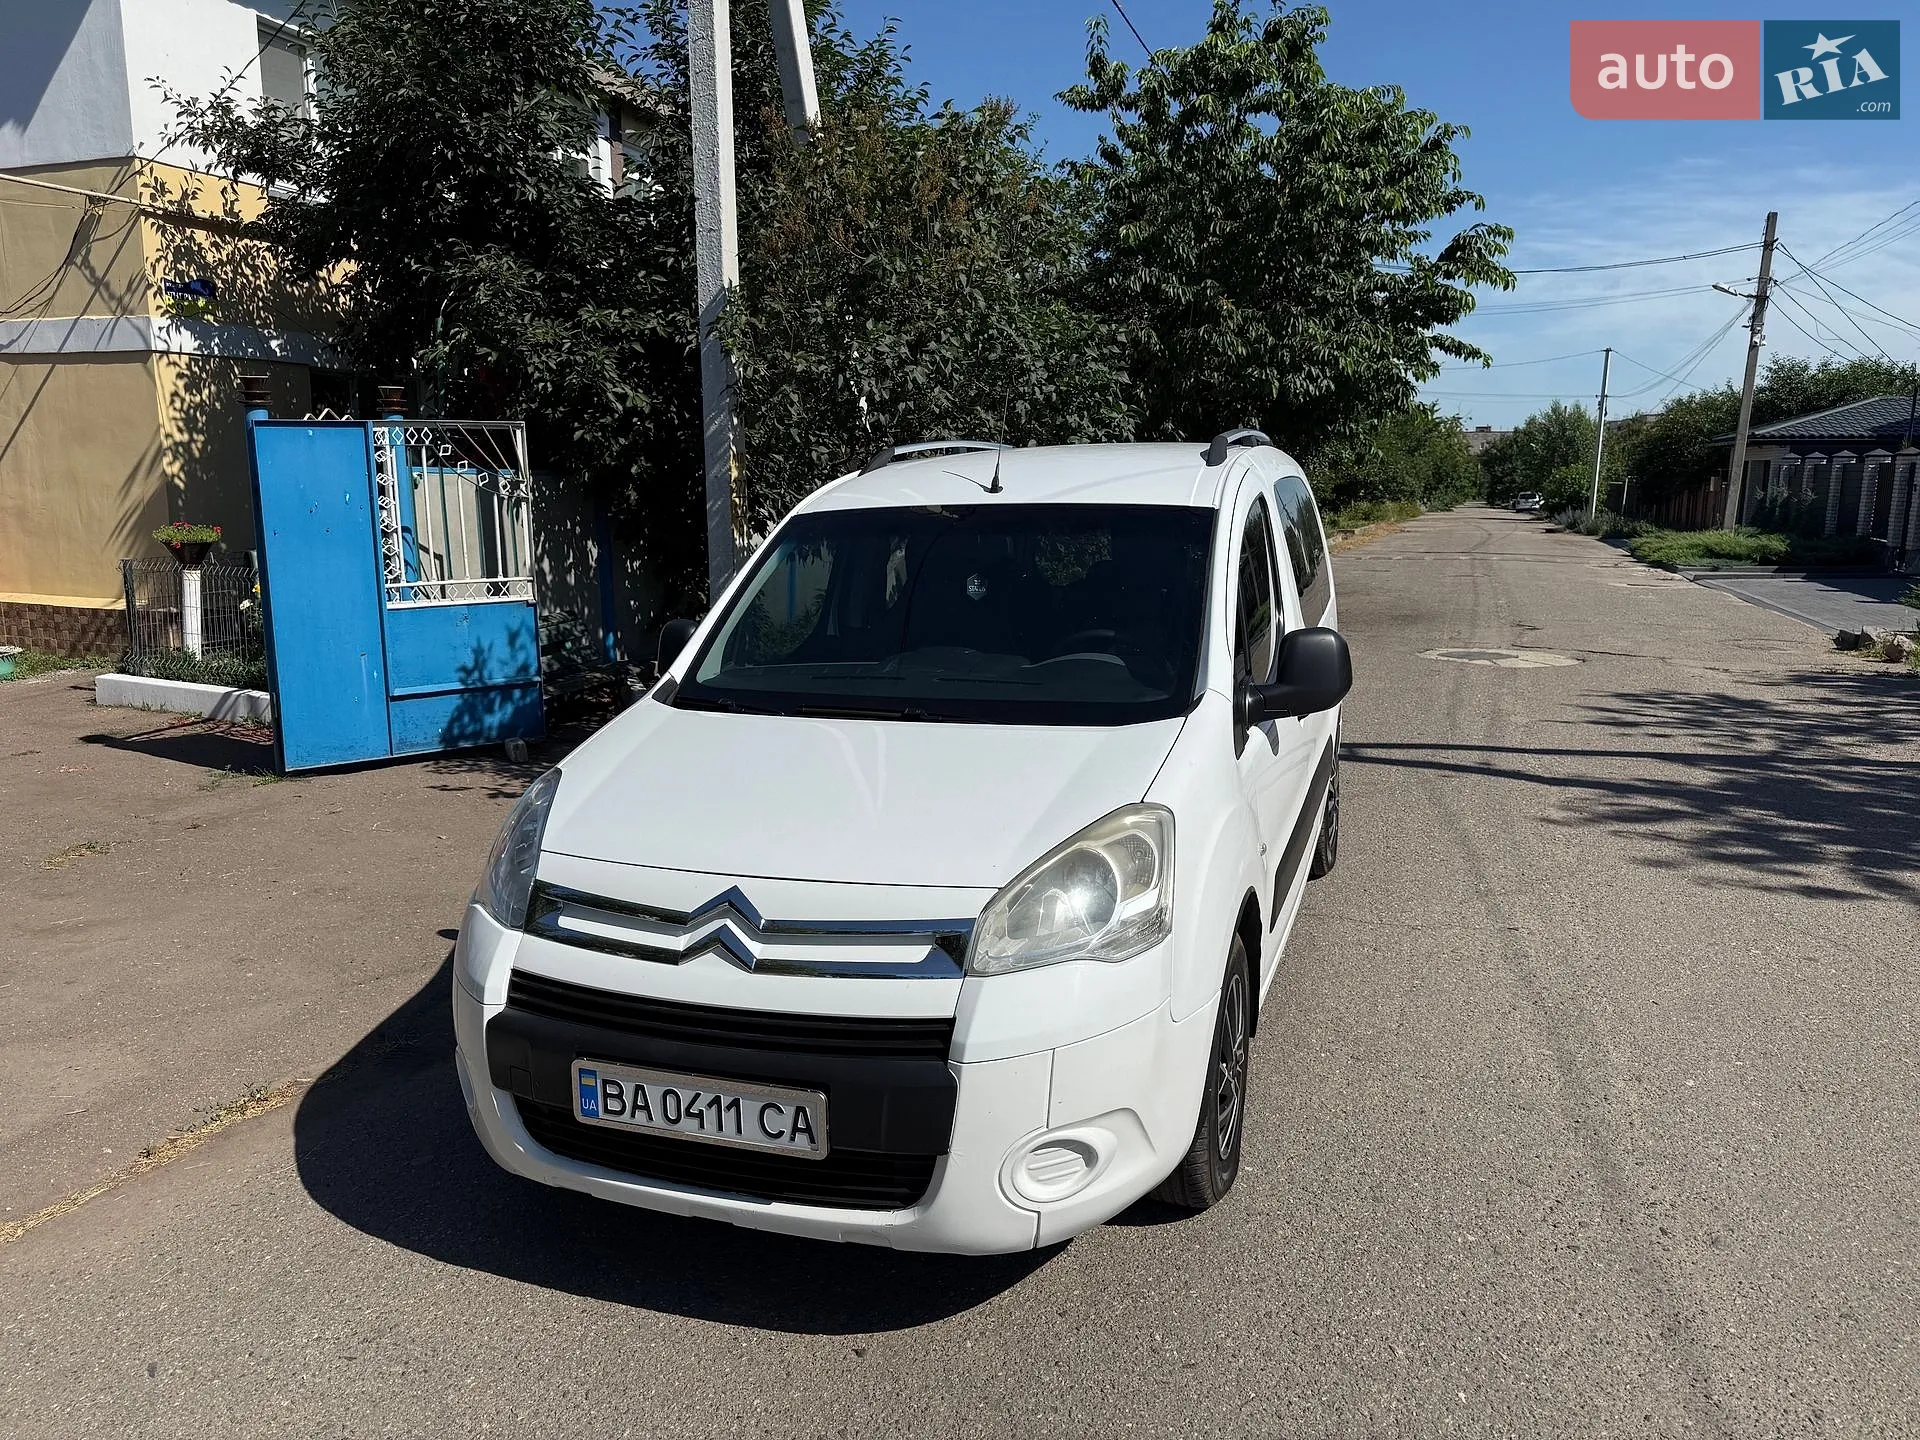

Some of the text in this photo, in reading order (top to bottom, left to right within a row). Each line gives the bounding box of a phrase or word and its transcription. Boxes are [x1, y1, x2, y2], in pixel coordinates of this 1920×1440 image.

[582, 1097, 598, 1112] UA
[601, 1078, 817, 1145] BA 0411 CA
